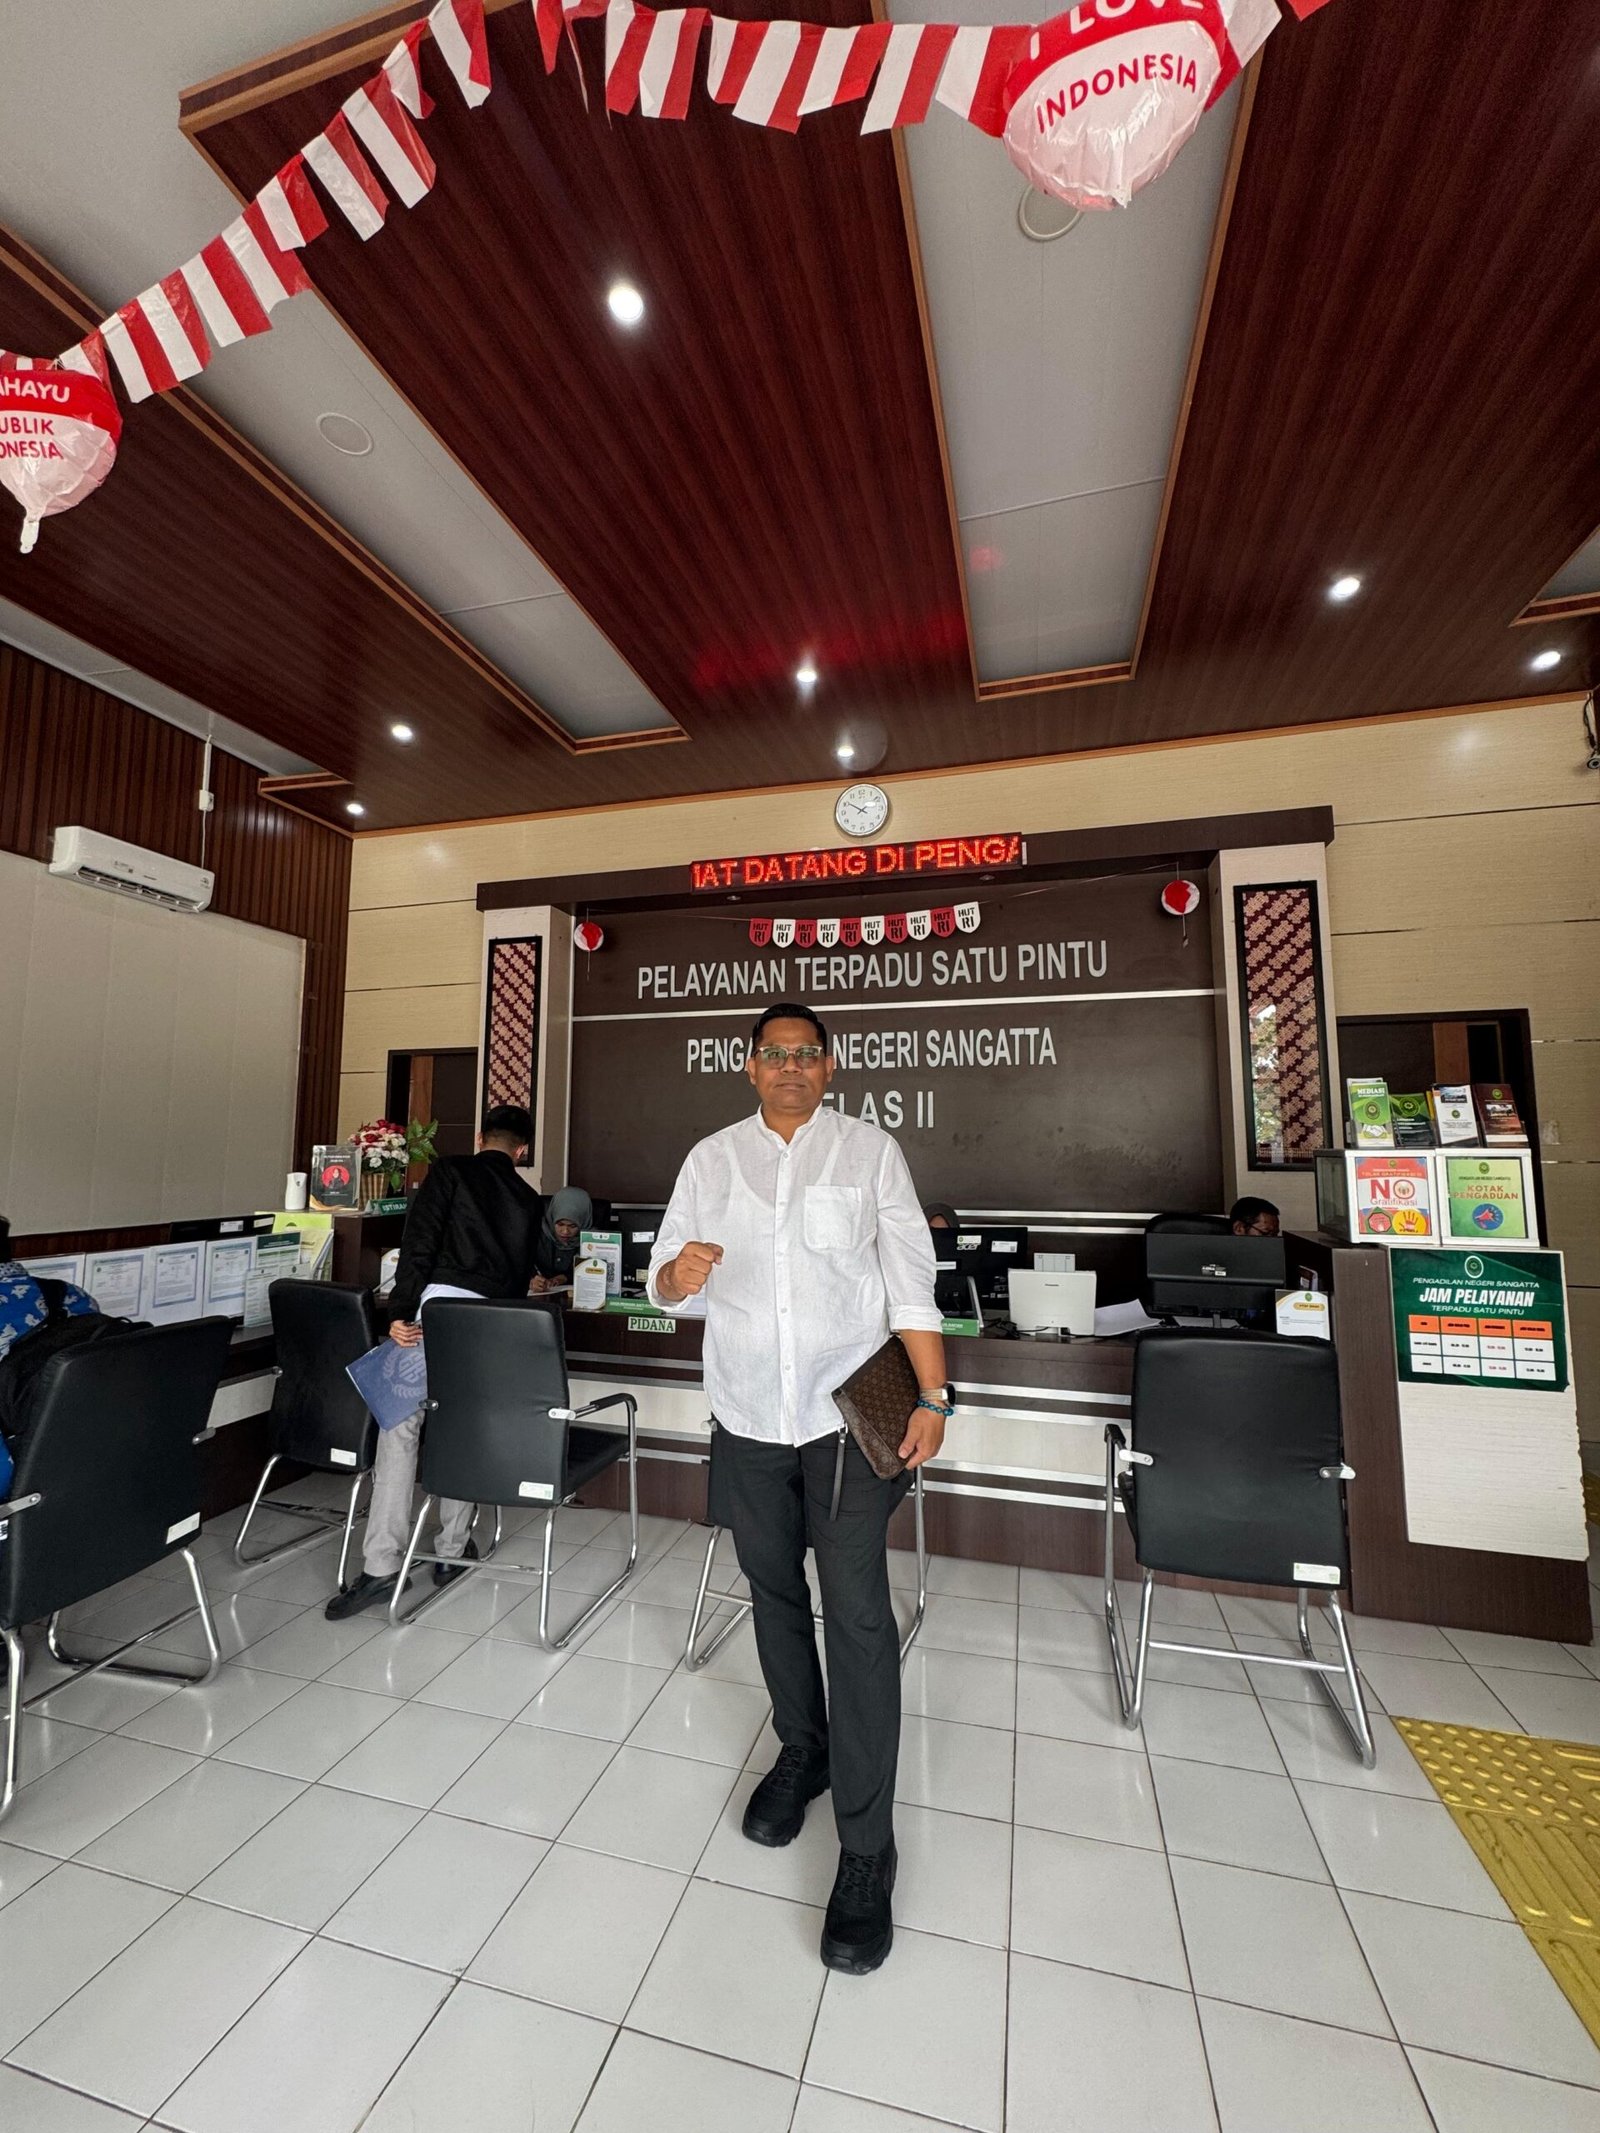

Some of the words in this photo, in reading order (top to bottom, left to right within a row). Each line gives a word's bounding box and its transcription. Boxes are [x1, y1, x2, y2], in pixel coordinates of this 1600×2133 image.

[1030, 31, 1040, 61] I
[1070, 0, 1204, 35] LO
[1036, 53, 1197, 133] INDONESIA
[744, 850, 867, 885] DATANG
[876, 846, 905, 873] DI
[934, 911, 951, 922] HUT
[958, 907, 975, 917] HUT
[864, 920, 881, 929] HUT
[888, 918, 904, 927] HUT
[910, 915, 927, 925] HUT
[962, 916, 974, 929] RI
[842, 922, 859, 930] HUT
[913, 924, 926, 936] RI
[937, 920, 949, 933] RI
[754, 931, 765, 942] RI
[777, 932, 789, 943] RI
[800, 932, 811, 943] RI
[822, 932, 834, 943] RI
[845, 931, 857, 942] RI
[867, 929, 878, 941] RI
[890, 927, 903, 939] RI
[638, 959, 786, 999] PELAYANAN
[794, 951, 922, 992] TERPADU
[932, 946, 1007, 986] SATU
[1018, 940, 1107, 981] PINTU
[833, 1031, 918, 1069] NEGERI
[926, 1027, 1057, 1068] SANGATTA
[917, 1091, 934, 1128] II
[1454, 1192, 1519, 1200] PENGADUAN
[1413, 1277, 1464, 1286] PENGADILAN
[1465, 1279, 1495, 1287] NEGERI
[1419, 1287, 1452, 1303] JAM
[1454, 1288, 1535, 1307] PELAYANAN
[1432, 1305, 1472, 1313] TERPADU
[1473, 1306, 1497, 1314] SATU
[1498, 1308, 1525, 1316] PINTU
[630, 1317, 675, 1332] PIDANA
